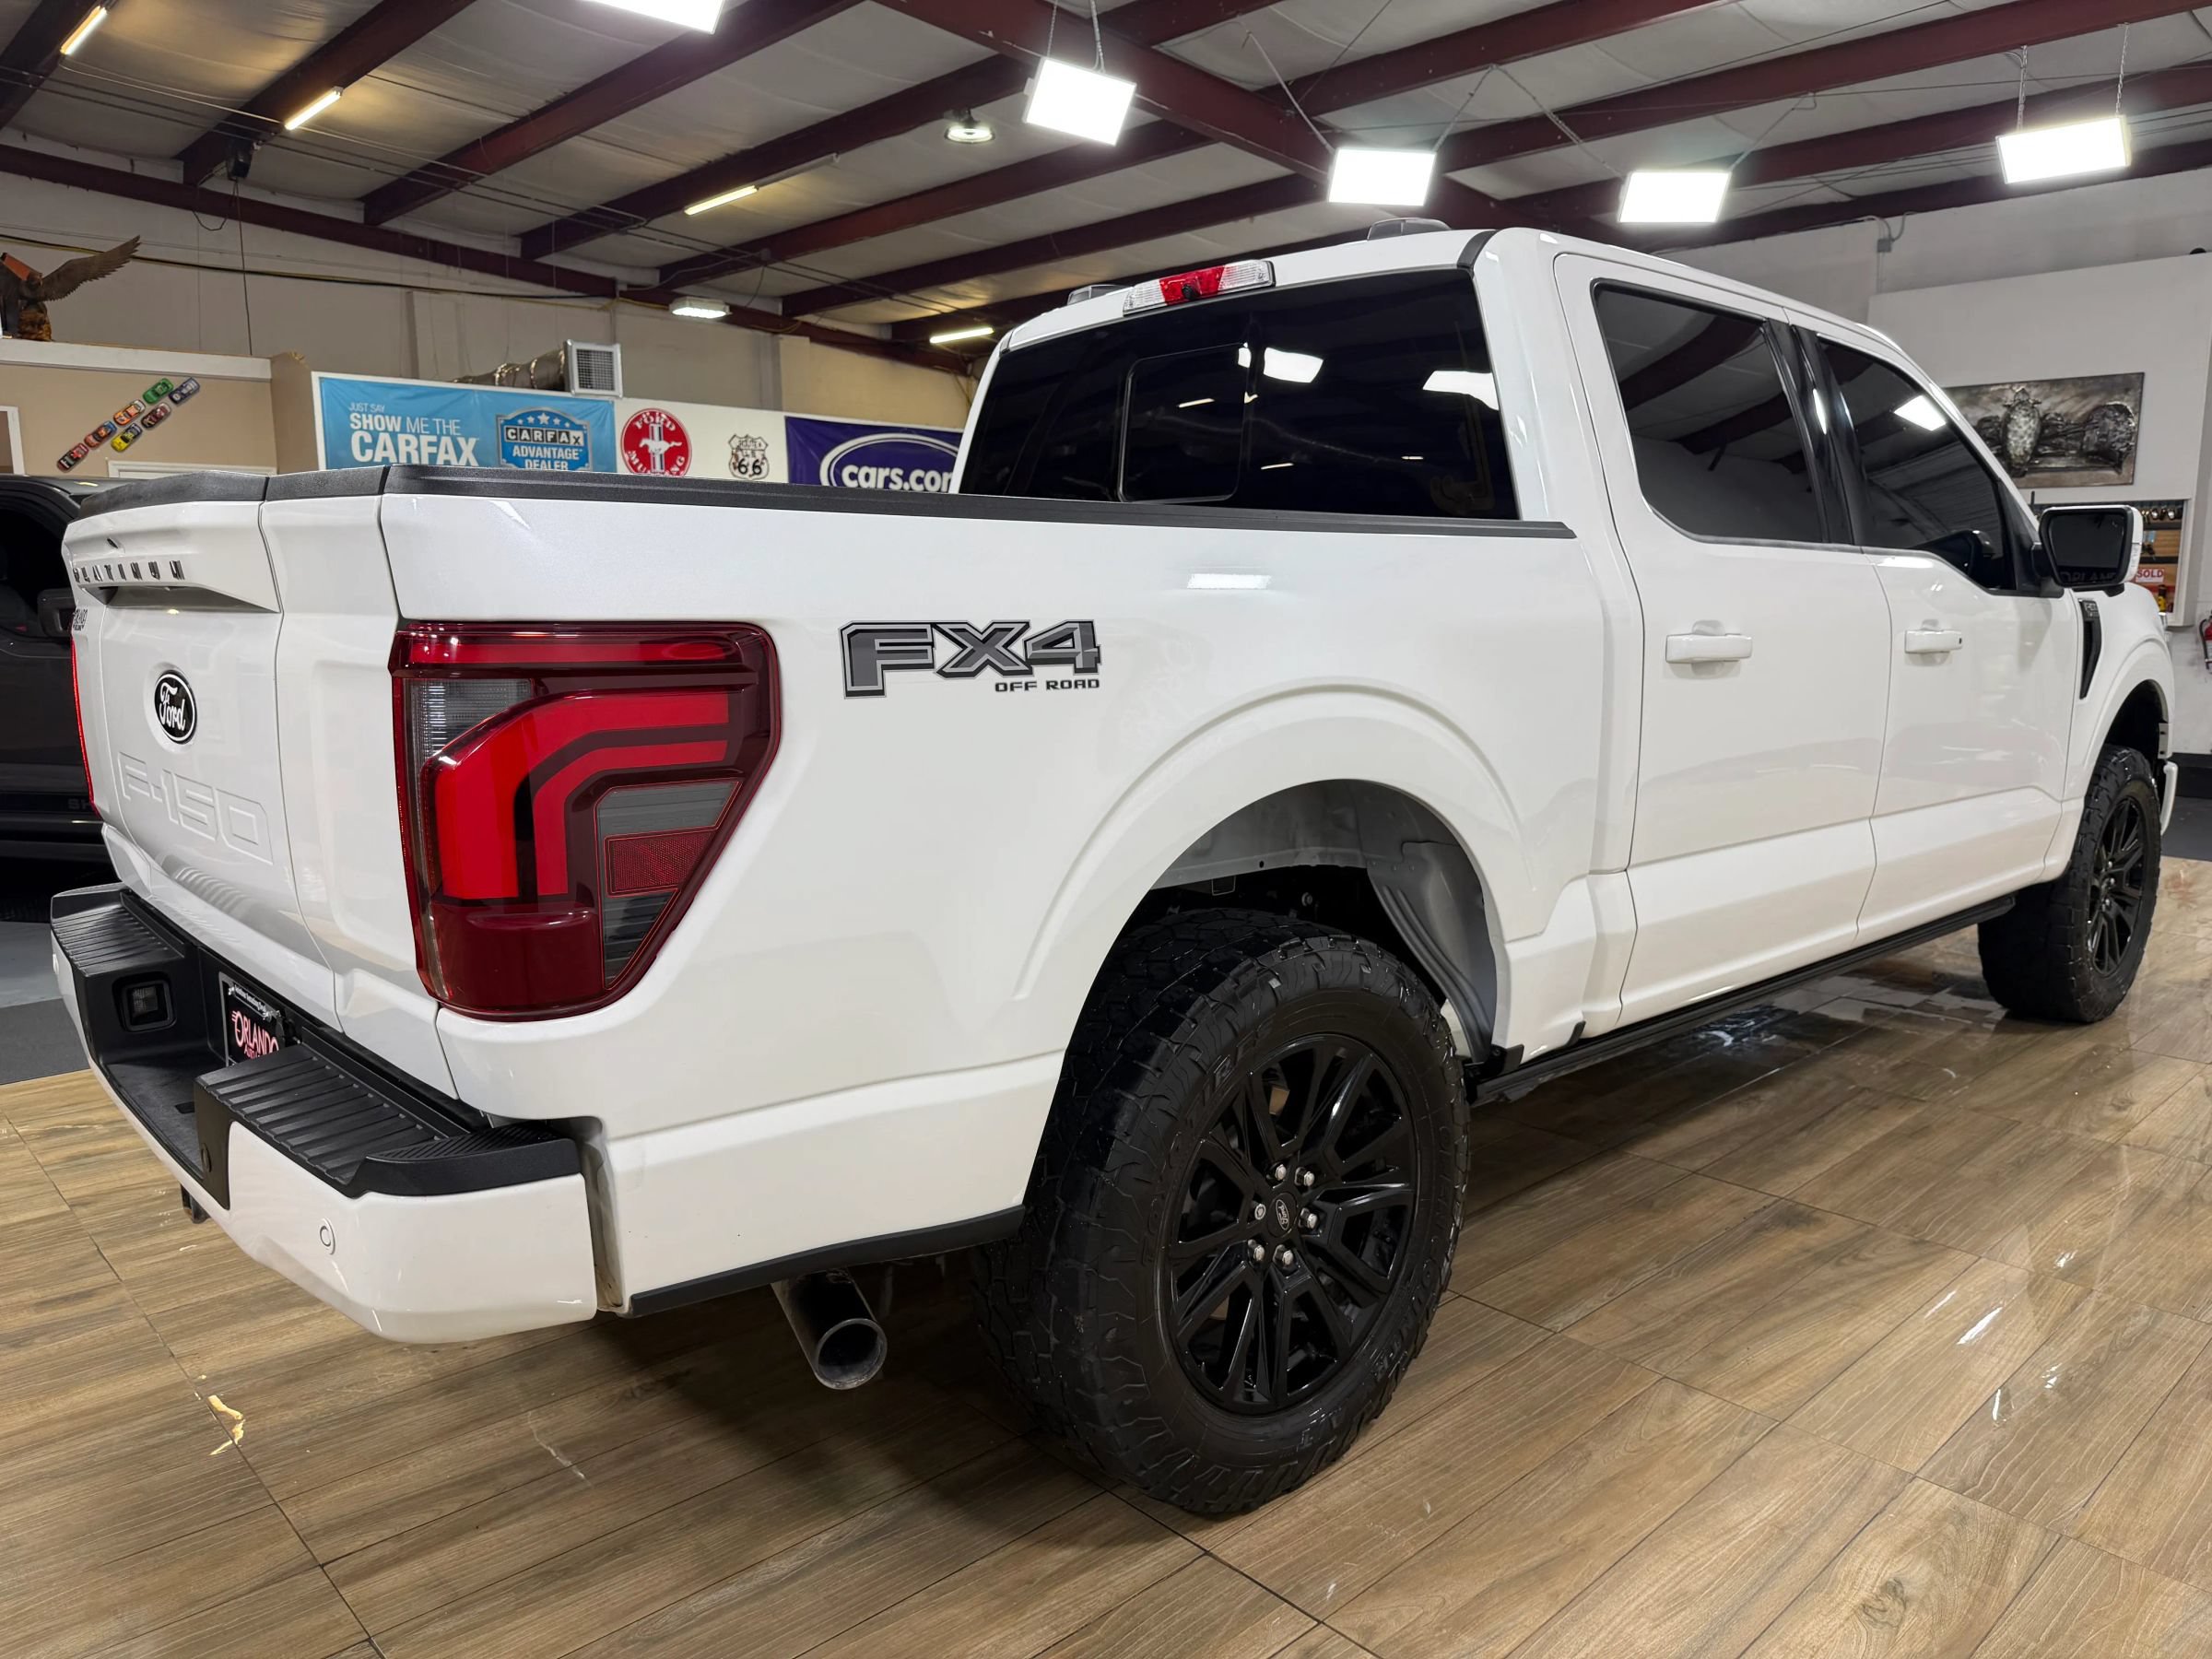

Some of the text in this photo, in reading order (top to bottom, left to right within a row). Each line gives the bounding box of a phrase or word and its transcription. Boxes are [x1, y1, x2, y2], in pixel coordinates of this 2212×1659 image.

[349, 403, 385, 413] JUST SAY
[350, 413, 461, 435] SHOW ME THE
[635, 411, 677, 431] FORD
[507, 427, 583, 446] CARFAX
[351, 430, 479, 466] CARFAX
[512, 444, 580, 461] ADVANTAGE
[524, 459, 569, 471] DEALER
[737, 458, 762, 476] 66
[73, 559, 185, 583] PLATINUM
[2137, 569, 2164, 578] SOLD
[840, 619, 1102, 700] FX4
[995, 678, 1100, 692] OFF ROAD
[159, 682, 186, 731] Ford
